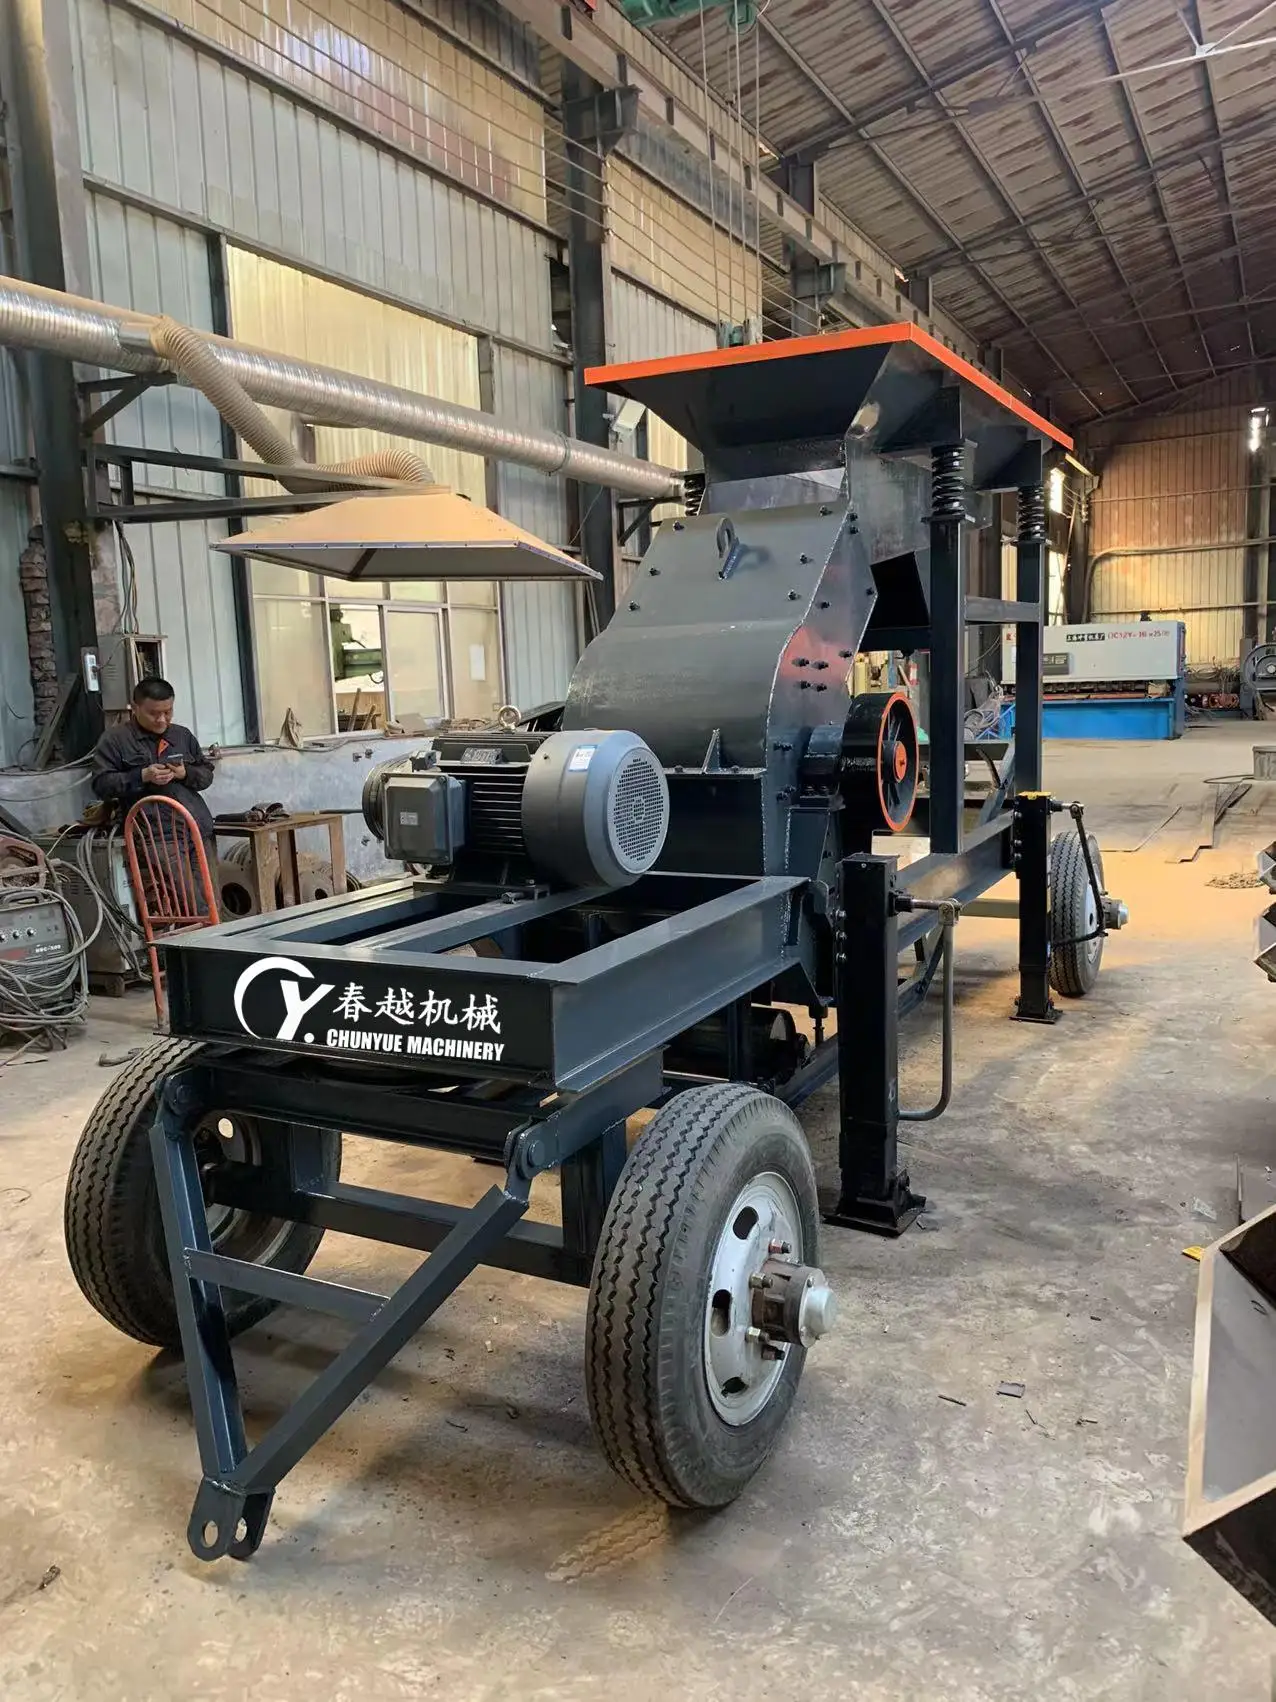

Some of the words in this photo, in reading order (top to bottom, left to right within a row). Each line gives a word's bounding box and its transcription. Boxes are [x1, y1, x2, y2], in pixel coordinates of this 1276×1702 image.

[332, 981, 501, 1035] 春越机械
[326, 1028, 402, 1053] CHUNYUE
[406, 1035, 505, 1062] MACHINERY
